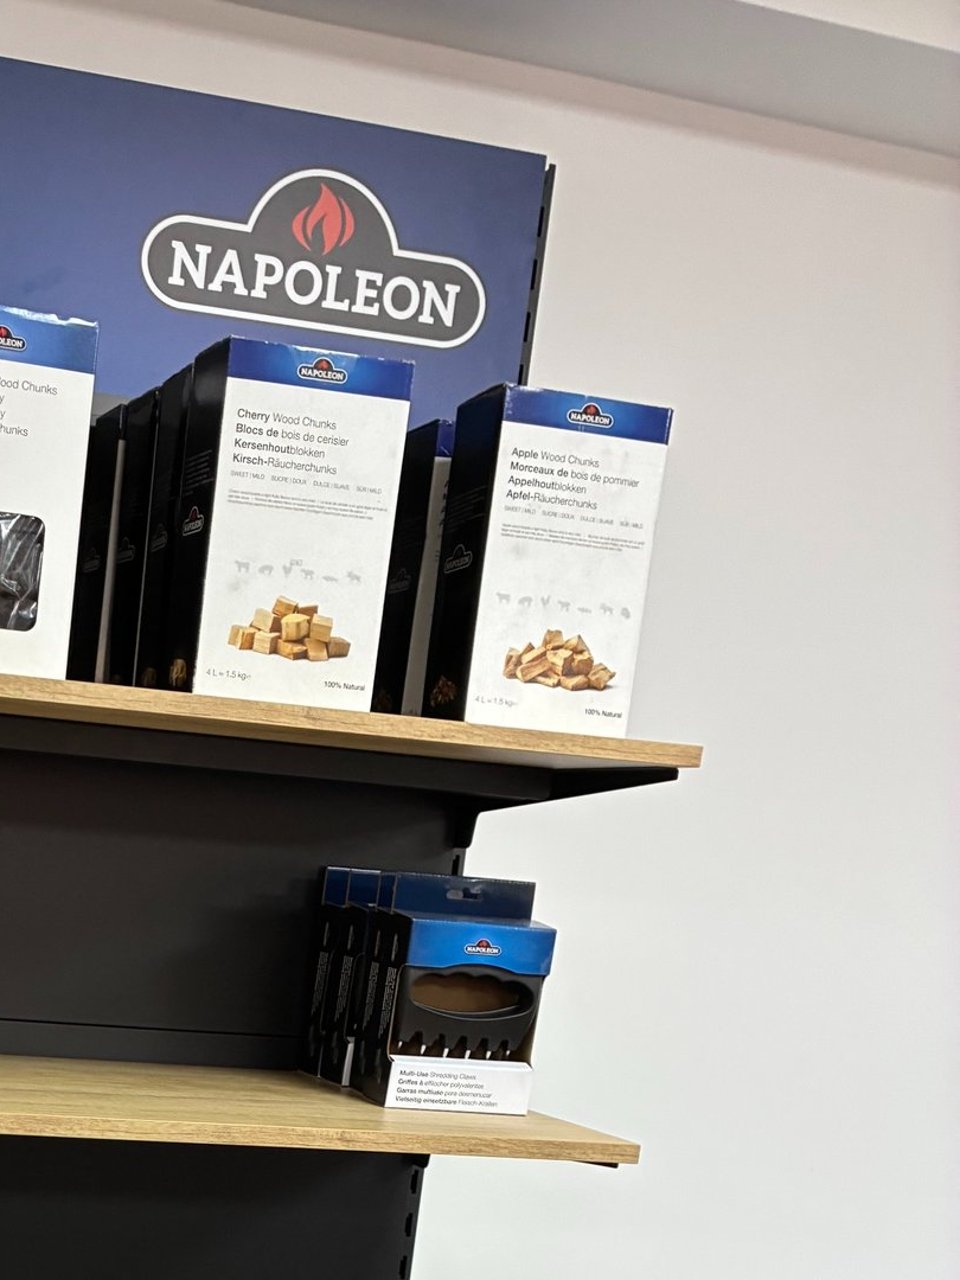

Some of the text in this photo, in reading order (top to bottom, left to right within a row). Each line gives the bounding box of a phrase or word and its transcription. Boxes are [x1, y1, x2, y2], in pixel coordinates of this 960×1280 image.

[167, 239, 462, 329] NAPOLEON
[300, 368, 344, 381] NAPOLEON
[22, 381, 58, 395] Chunks
[237, 408, 337, 430] Cherry Wood Chunks
[570, 412, 610, 425] NAPOLEON
[236, 423, 349, 446] Blocs de bois de cerisier
[234, 438, 325, 458] Kersenhoutblokken
[232, 453, 337, 475] Kirsch-Räucherchunks
[511, 448, 600, 467] Apple Wood Chunks
[510, 462, 640, 487] Morceaux de bois de pommier
[508, 475, 587, 494] Appelhoutblokken
[343, 682, 365, 691] Natural
[601, 709, 622, 718] Natural
[466, 946, 501, 954] NAPOLEON
[429, 1072, 458, 1080] Shredding
[395, 1096, 422, 1104] Vielseitig
